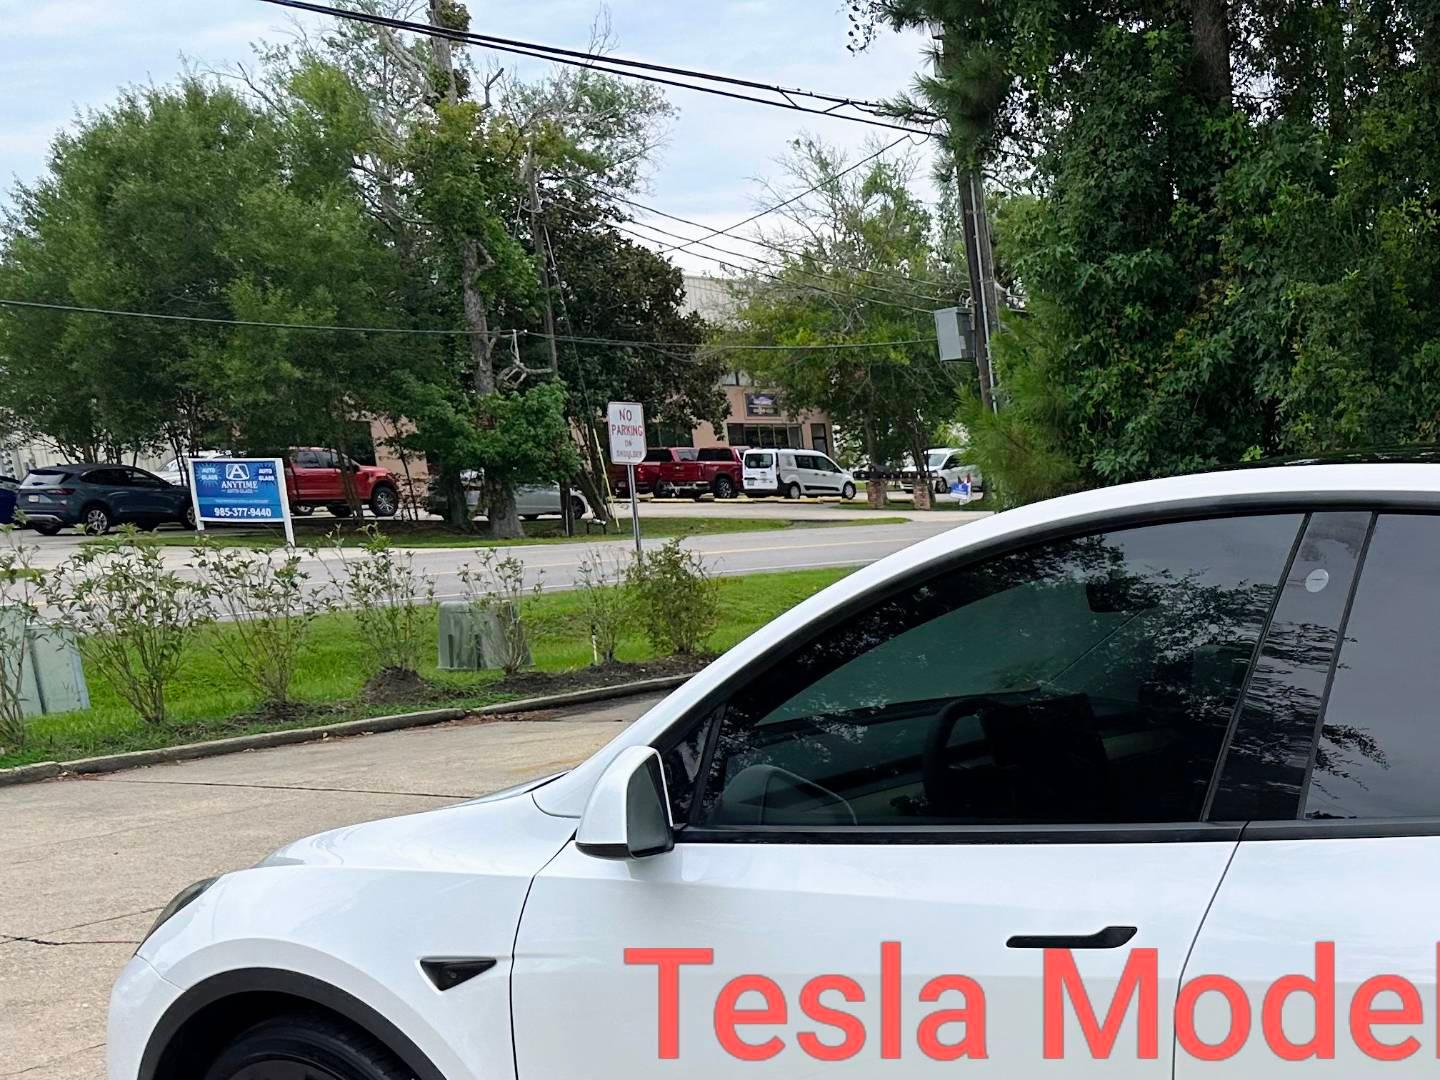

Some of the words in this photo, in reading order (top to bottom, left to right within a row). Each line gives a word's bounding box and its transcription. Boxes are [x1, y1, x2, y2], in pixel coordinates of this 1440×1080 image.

[619, 409, 632, 421] NO
[611, 424, 643, 436] PARKING
[221, 481, 258, 489] ANYTIME
[214, 507, 272, 517] 985-377-9440
